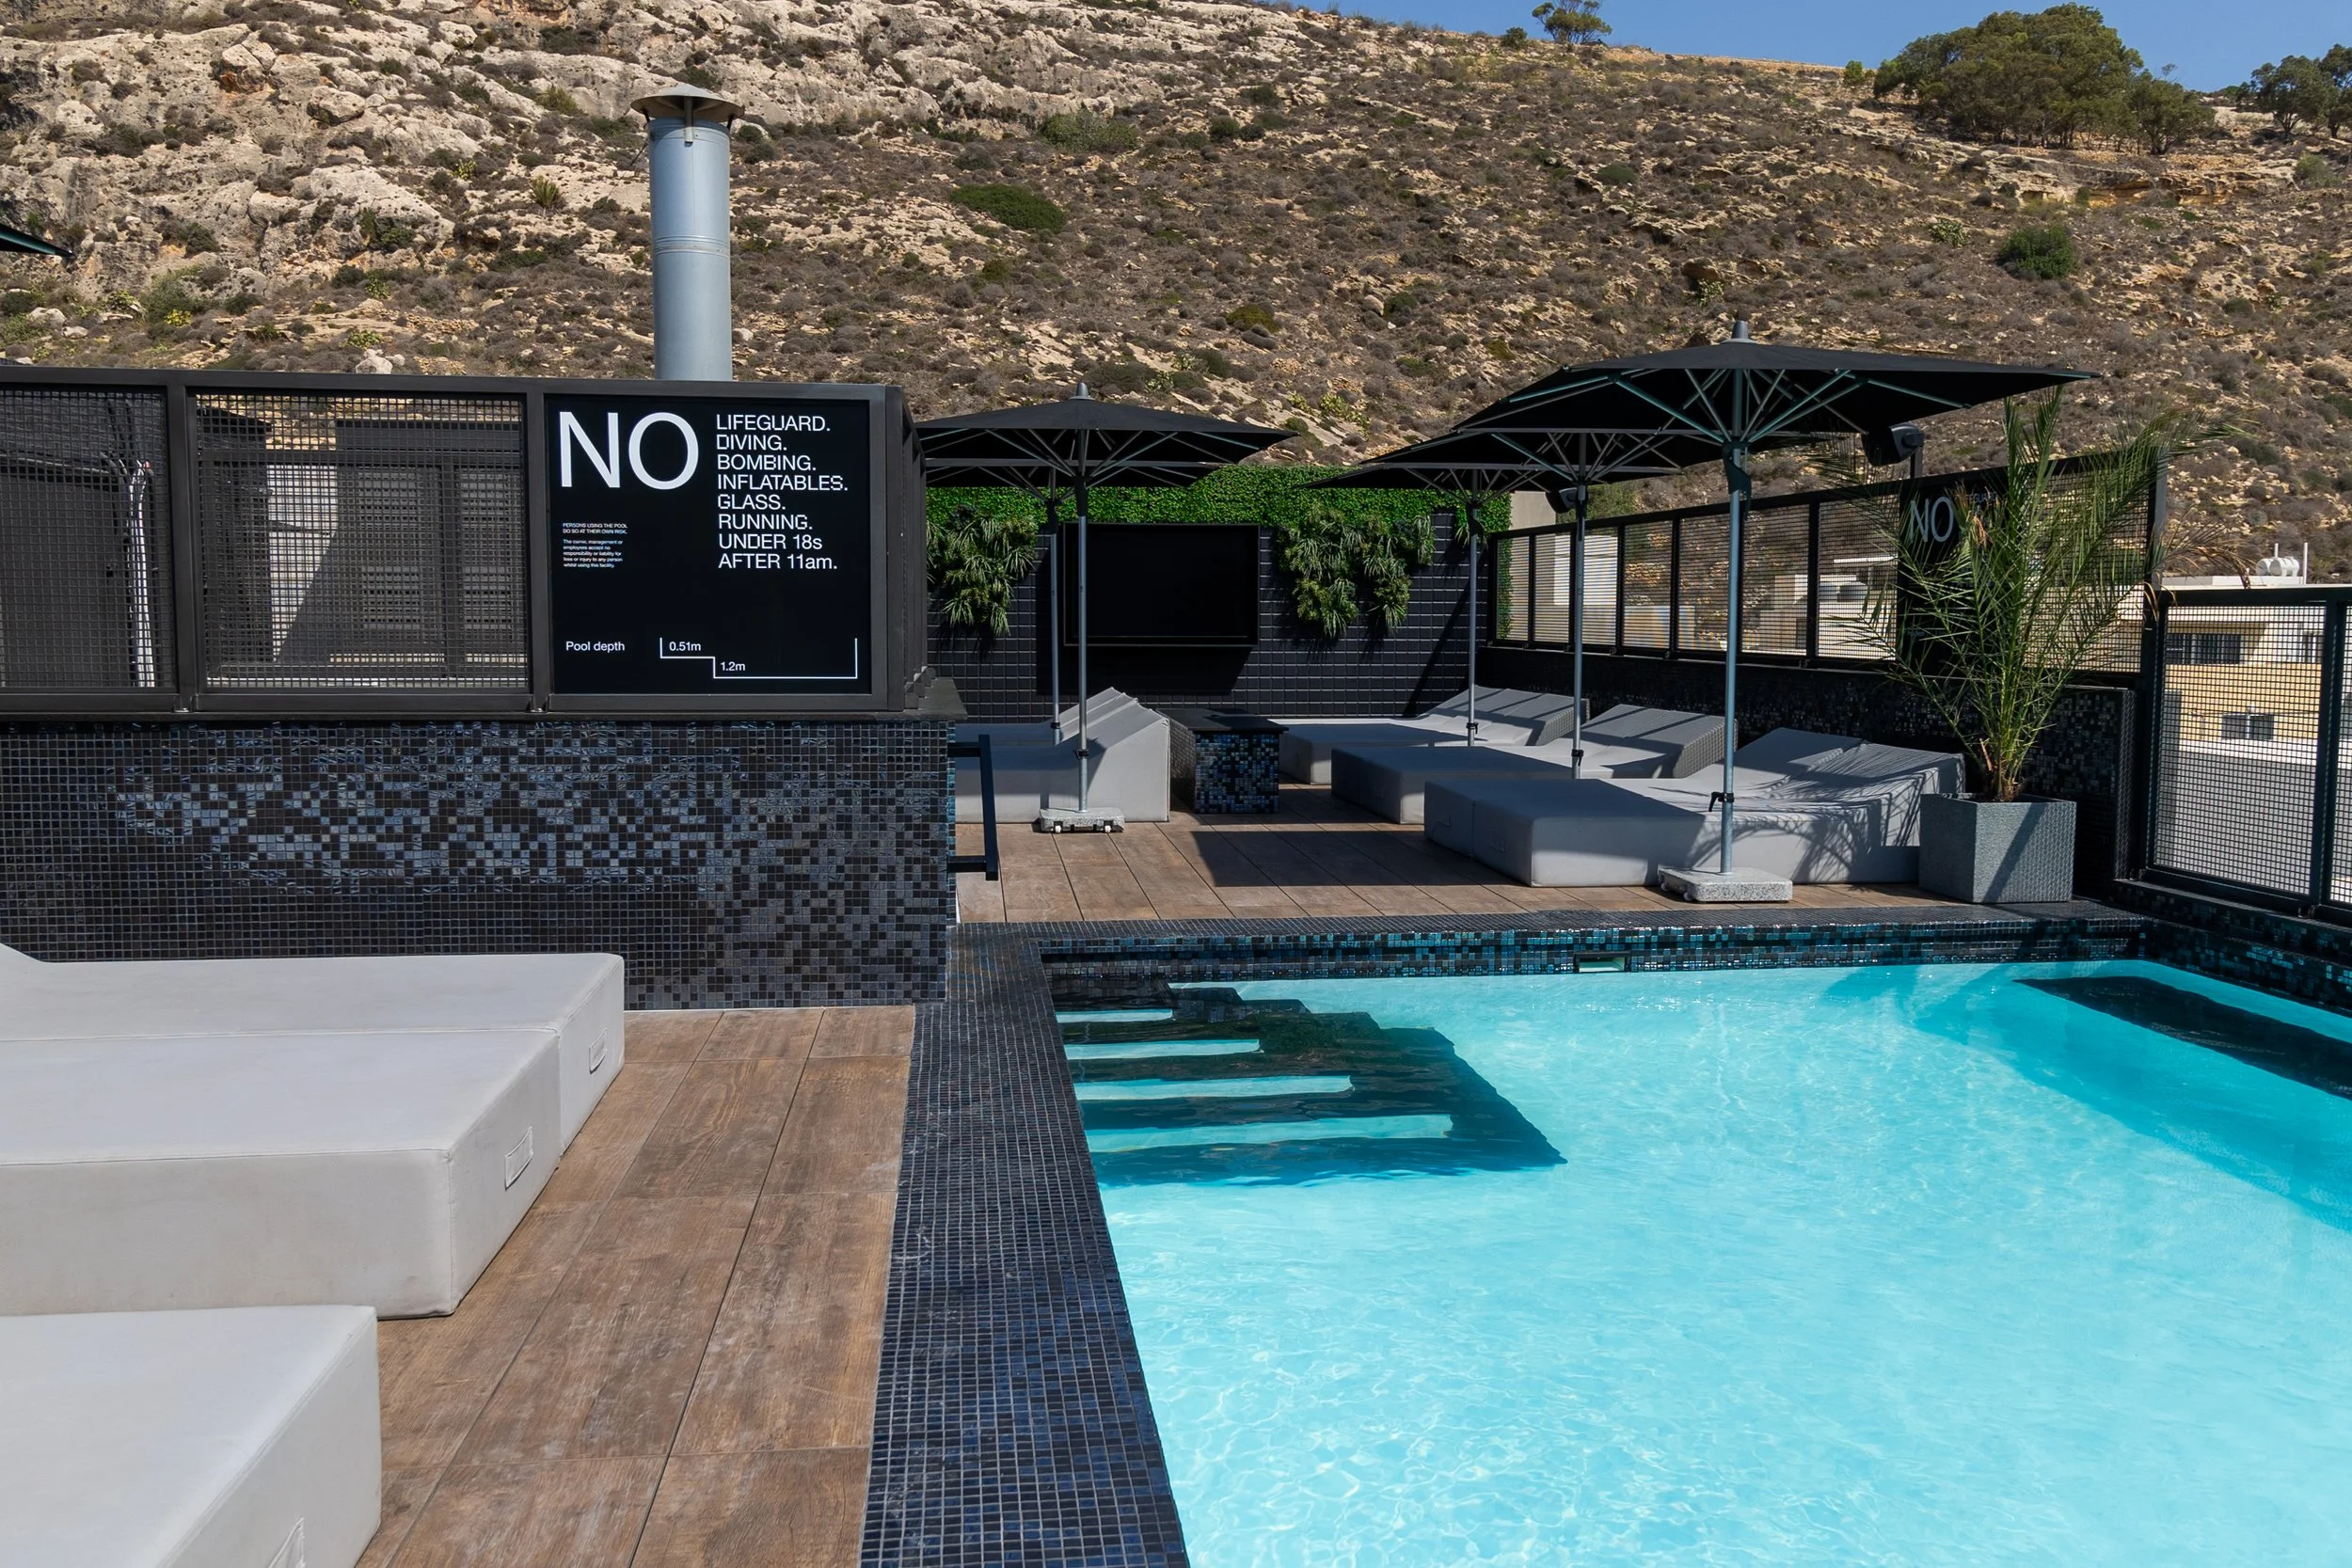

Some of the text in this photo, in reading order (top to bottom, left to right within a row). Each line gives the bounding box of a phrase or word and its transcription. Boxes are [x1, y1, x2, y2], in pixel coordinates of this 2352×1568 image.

[716, 414, 831, 432] LIFEGUARD.
[560, 411, 699, 490] NO
[716, 434, 787, 451] DIVING.
[717, 453, 817, 471] BOMBING.
[718, 474, 849, 491] INFLATABLES.
[718, 494, 787, 510] GLASS.
[719, 514, 813, 531] RUNNING.
[1910, 497, 1954, 543] NO
[719, 533, 822, 549] UNDER 18s
[719, 553, 837, 570] AFTER 11am.
[565, 641, 626, 656] Pool depth
[669, 641, 702, 652] 0.51m
[720, 661, 746, 672] 1.2m
